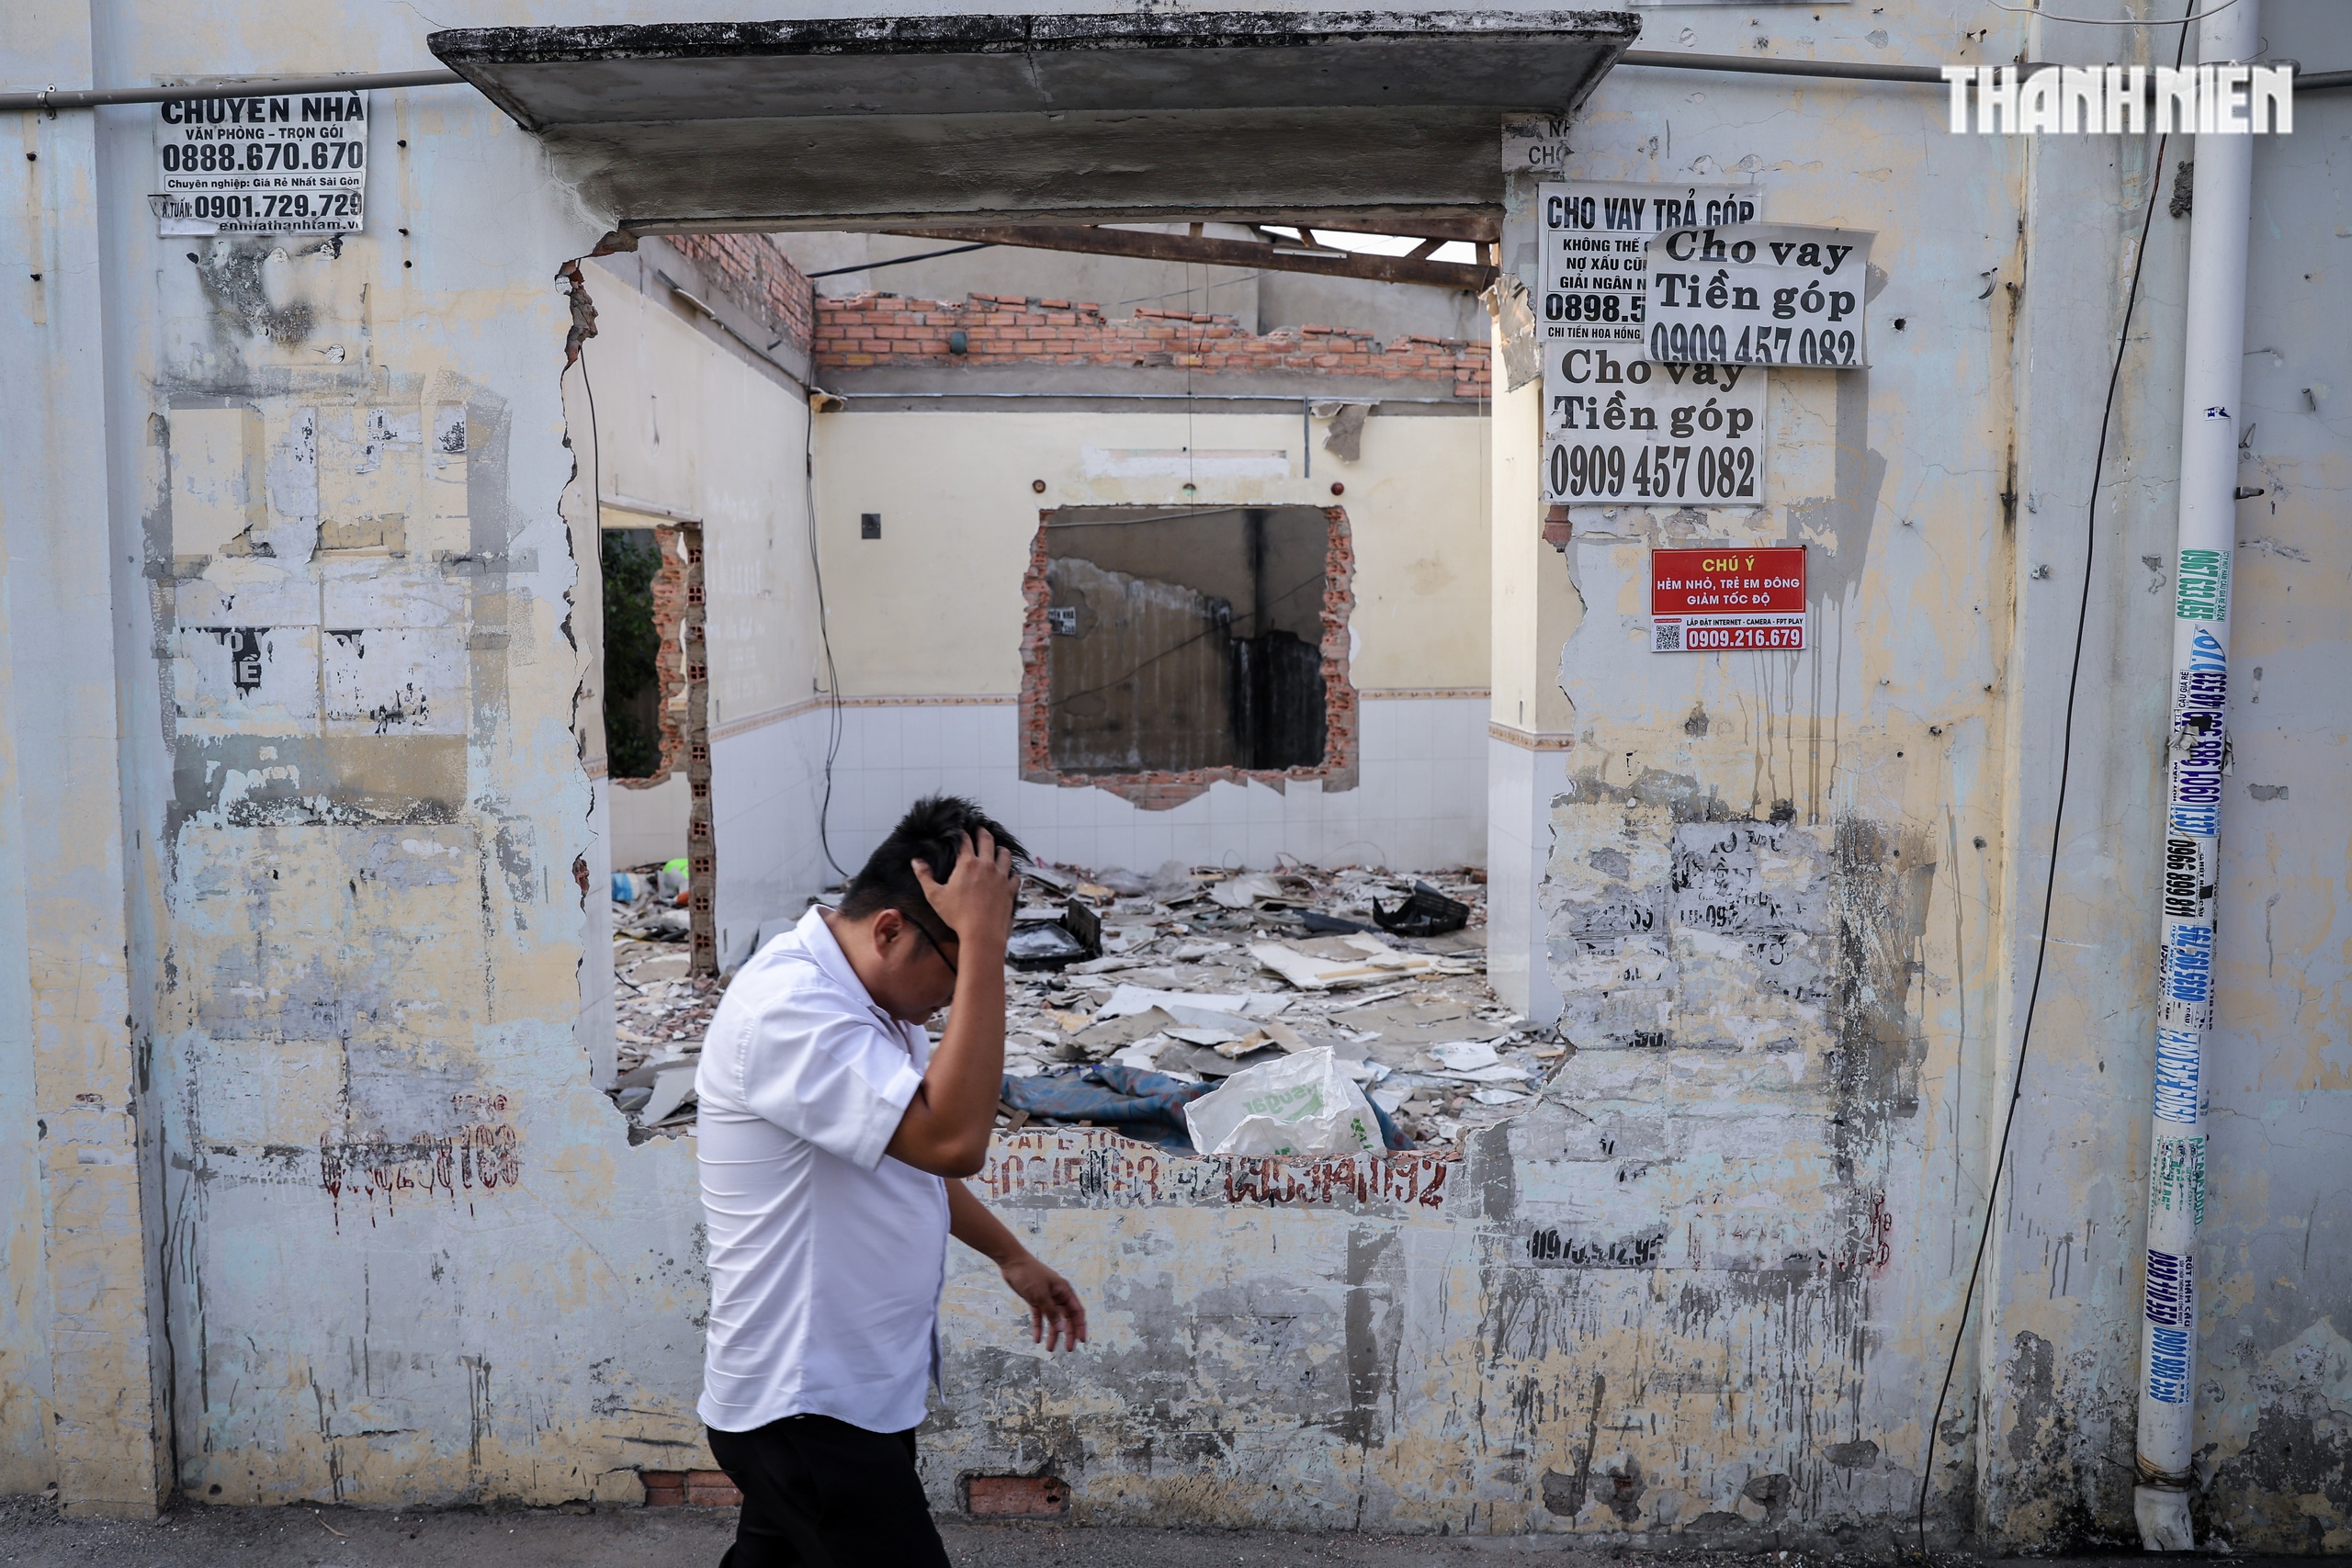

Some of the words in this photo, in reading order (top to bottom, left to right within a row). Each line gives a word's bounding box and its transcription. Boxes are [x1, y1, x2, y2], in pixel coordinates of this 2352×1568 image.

[301, 90, 365, 122] NHÀ
[186, 128, 213, 141] VĂN
[218, 127, 265, 140] PHÒNG
[278, 127, 315, 141] TRỌN
[320, 124, 344, 139] GÓI
[163, 142, 363, 172] 0888.670.670
[168, 179, 208, 190] Chuyên
[210, 178, 250, 190] nghiệp:
[253, 177, 271, 187] Giá
[274, 177, 288, 187] Rẻ
[291, 177, 317, 187] Nhất
[321, 177, 337, 186] Sài
[340, 176, 359, 186] Gòn
[195, 193, 362, 218] 0901.729.729
[1546, 196, 1595, 230] CHO
[1604, 197, 1645, 231] VAY
[1654, 188, 1697, 231] TRẢ
[1706, 193, 1754, 225] GÓP
[1563, 237, 1611, 252] KHÔNG
[1615, 237, 1640, 253] THẾ
[1666, 229, 1757, 264] Cho
[1769, 241, 1853, 275] vay
[1566, 256, 1588, 273] NỢ
[1590, 254, 1619, 271] XẤU
[1623, 257, 1647, 271] CŨ
[1560, 273, 1588, 288] GIẢI
[1593, 276, 1633, 290] NGÂN
[1655, 268, 1760, 310] Tiền
[1772, 280, 1856, 321] góp
[1546, 293, 1645, 322] 0898.5
[1548, 327, 1565, 338] CHI
[1592, 328, 1611, 338] HOA
[1651, 321, 1727, 362] 0909
[1736, 325, 1792, 364] 457
[1799, 328, 1857, 366] 082
[1562, 349, 1652, 384] Cho
[1664, 362, 1747, 392] vay
[1554, 389, 1657, 430] Tiền
[1670, 398, 1754, 438] góp
[1551, 445, 1625, 496] 0909
[1633, 446, 1690, 497] 457
[1698, 446, 1755, 498] 082
[1702, 555, 1739, 571] CHÚ
[1745, 554, 1756, 571] Ý
[1657, 577, 1681, 590] HẺM
[1686, 578, 1716, 591] NHỎ,
[1720, 576, 1740, 589] TRẺ
[1744, 579, 1759, 588] EM
[1764, 577, 1800, 589] ĐÔNG
[2177, 550, 2220, 620] 0967.633.455
[1687, 592, 1719, 604] GIẢM
[1723, 592, 1747, 604] TỐC
[1752, 592, 1770, 606] ĐỘ
[1689, 629, 1800, 648] 0909.216.679
[2188, 673, 2227, 708] 48.533
[2175, 805, 2215, 835] 1.337
